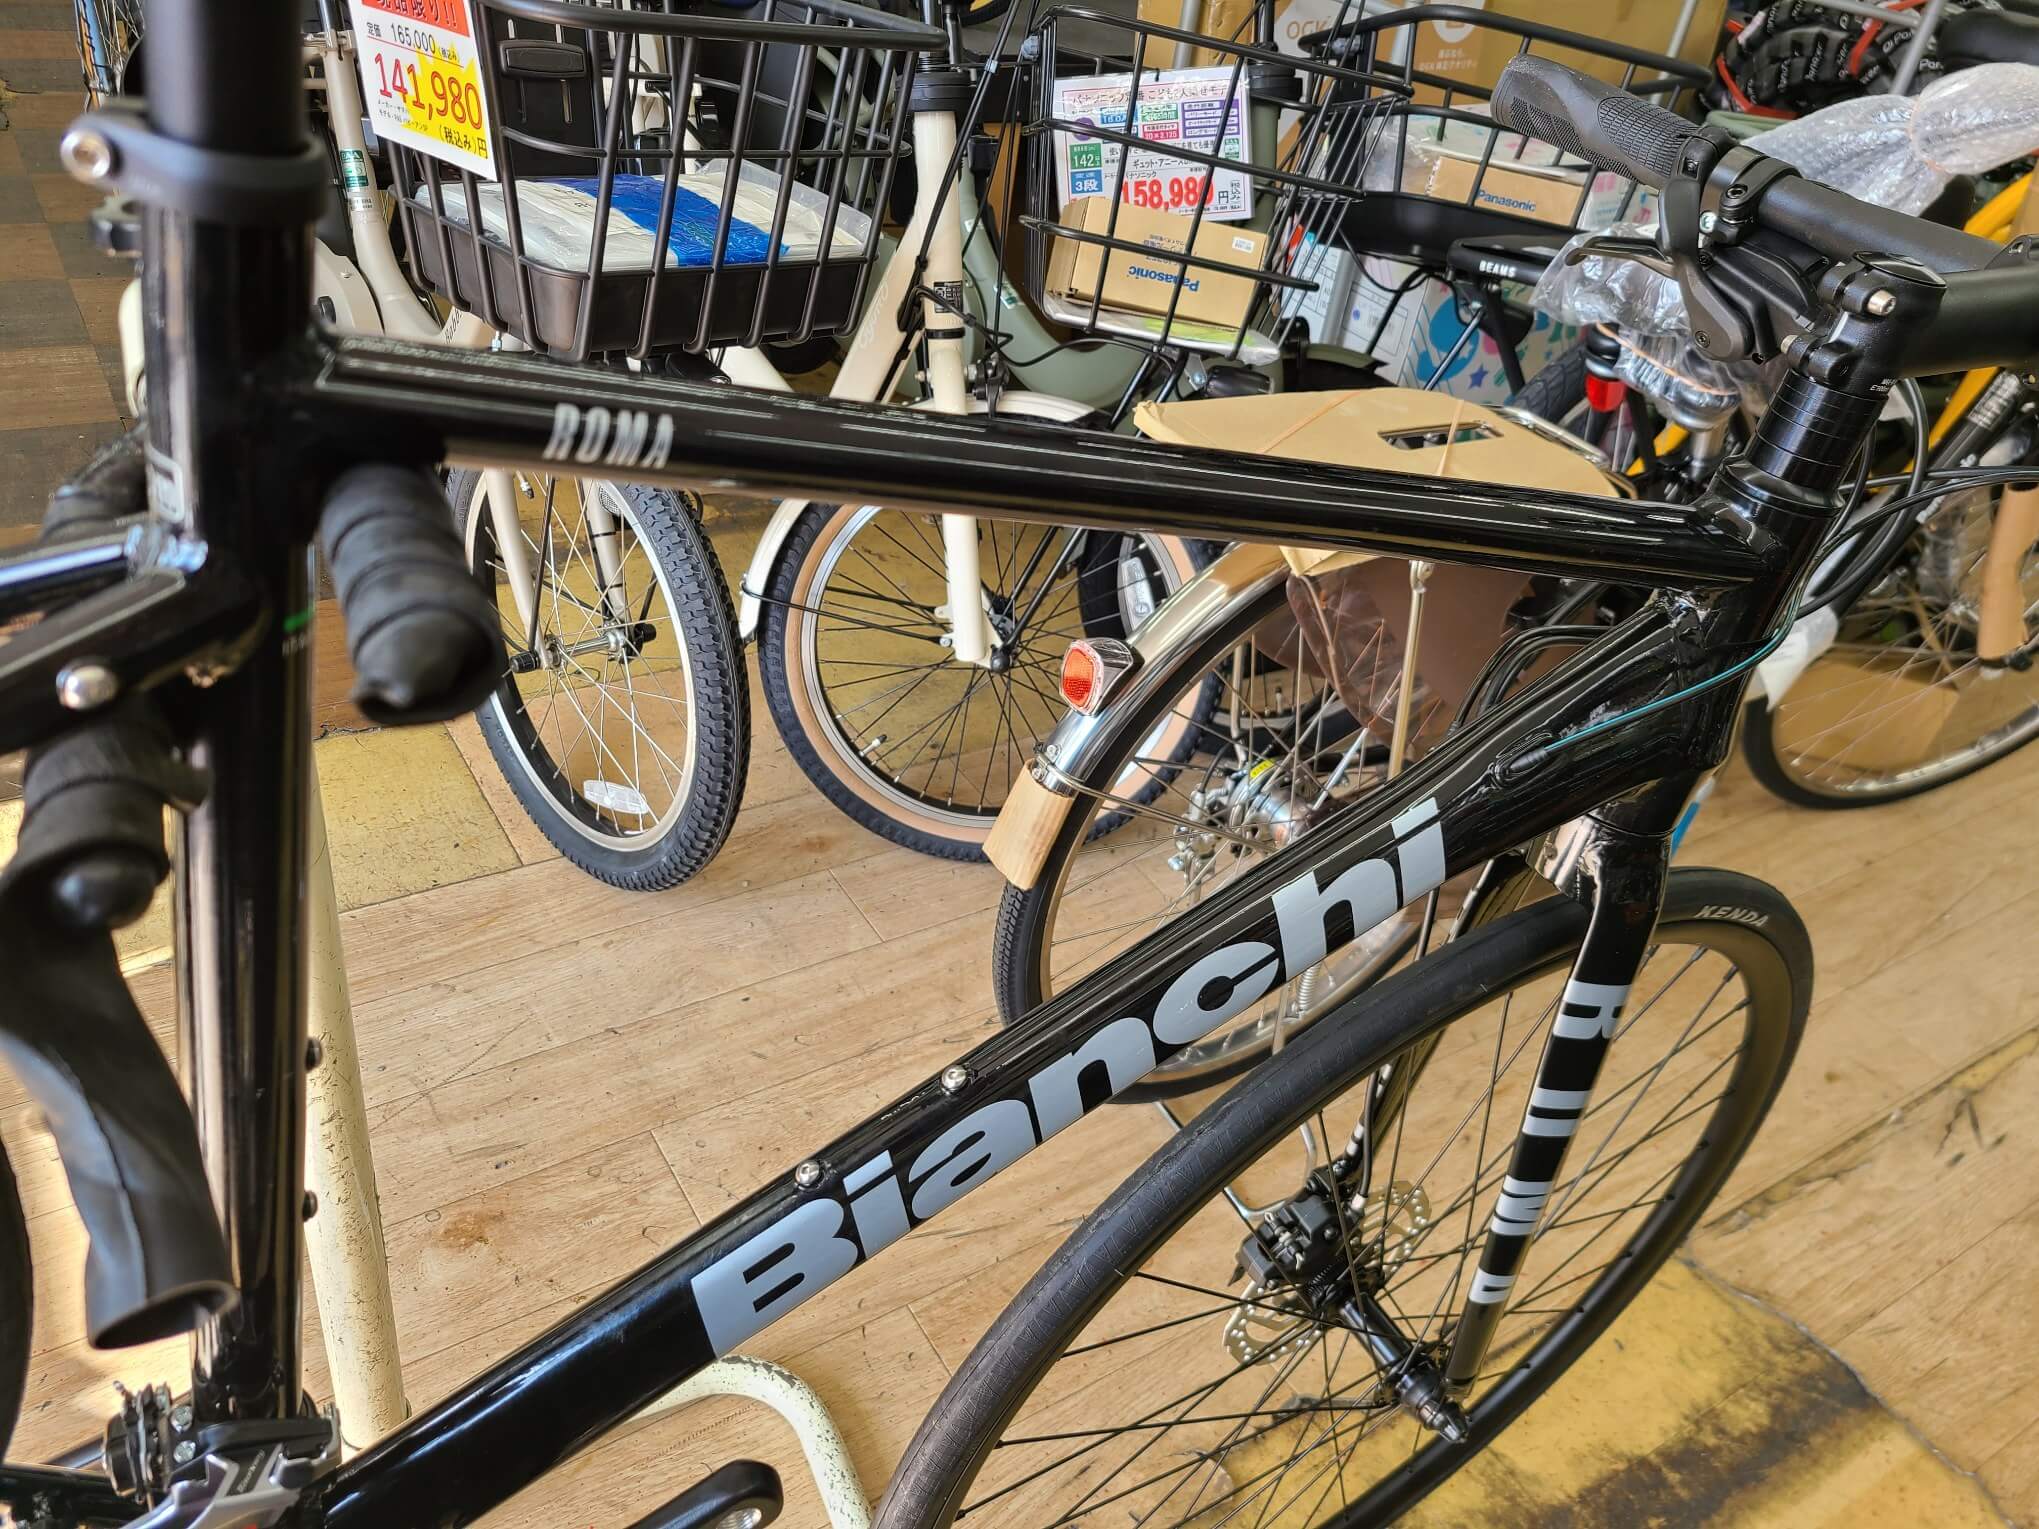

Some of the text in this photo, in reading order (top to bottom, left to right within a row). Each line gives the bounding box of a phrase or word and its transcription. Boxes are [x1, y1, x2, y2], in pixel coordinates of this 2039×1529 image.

[374, 52, 483, 130] 141,980
[1073, 153, 1095, 168] 142
[1075, 180, 1098, 192] 3段
[1218, 190, 1230, 205] 円
[1478, 188, 1538, 212] Panasonic
[1478, 259, 1518, 279] BEAMS
[542, 402, 675, 470] ROMA
[1693, 904, 1769, 928] KENDA
[691, 797, 1446, 1359] Bianchi
